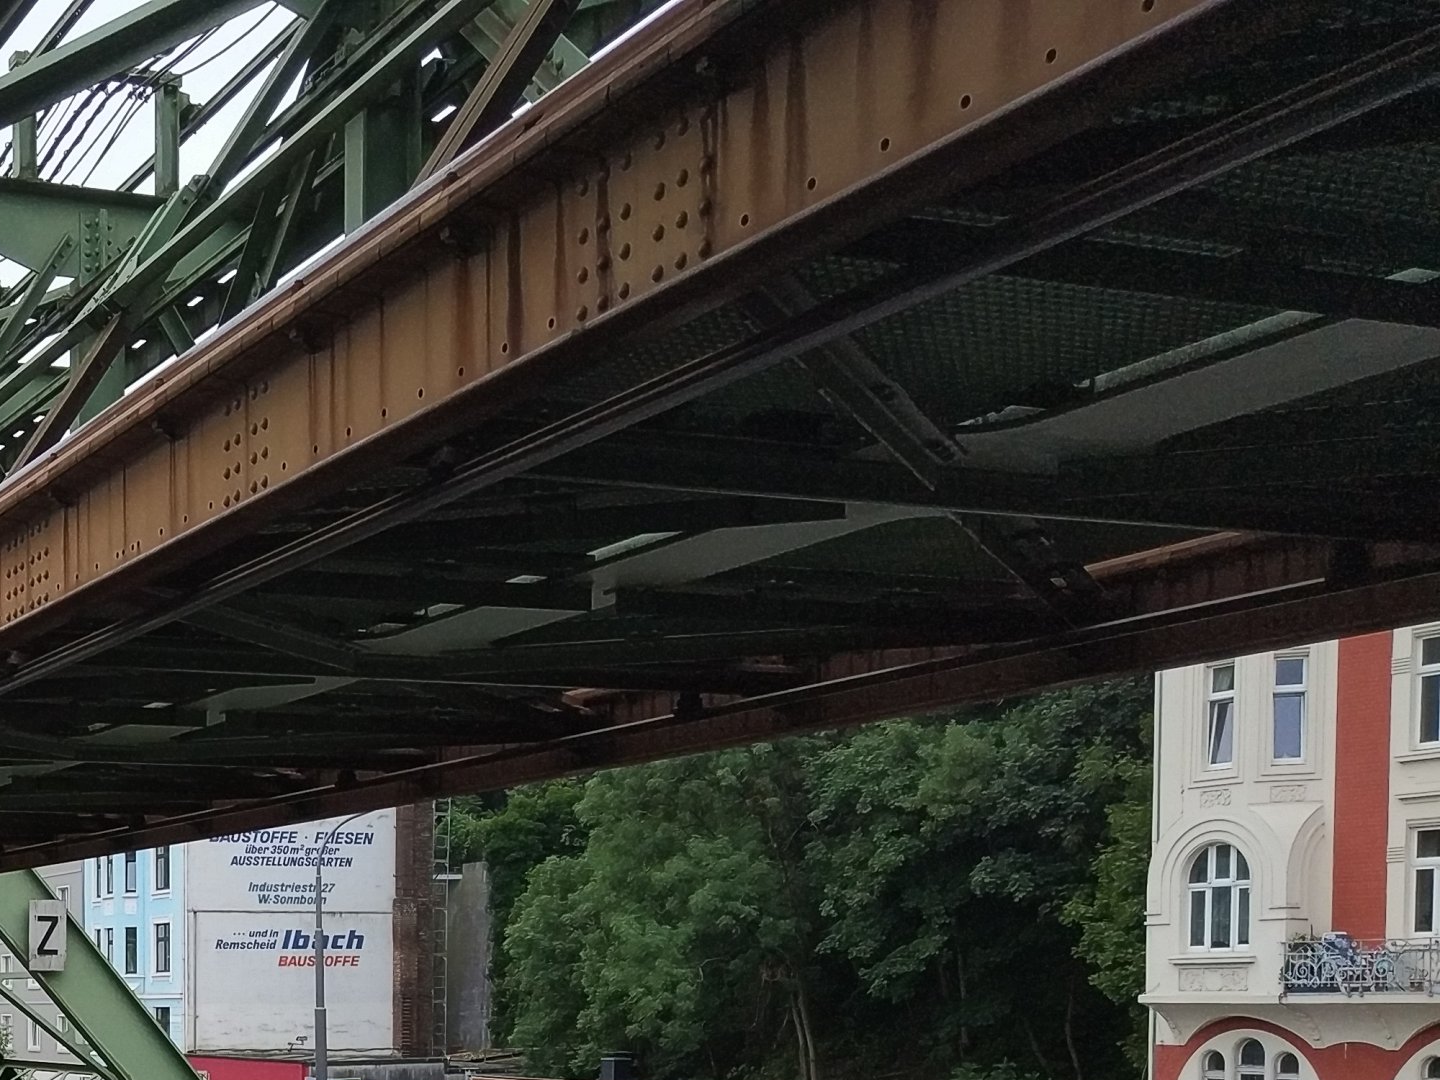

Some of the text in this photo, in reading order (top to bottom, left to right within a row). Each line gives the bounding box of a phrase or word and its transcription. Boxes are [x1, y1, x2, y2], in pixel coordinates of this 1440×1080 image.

[245, 844, 269, 855] über
[321, 883, 336, 893] 27
[37, 915, 59, 956] Z
[249, 929, 268, 938] und
[269, 929, 279, 938] in
[215, 939, 277, 950] Remscheid
[278, 955, 360, 967] BAUSOFFE
